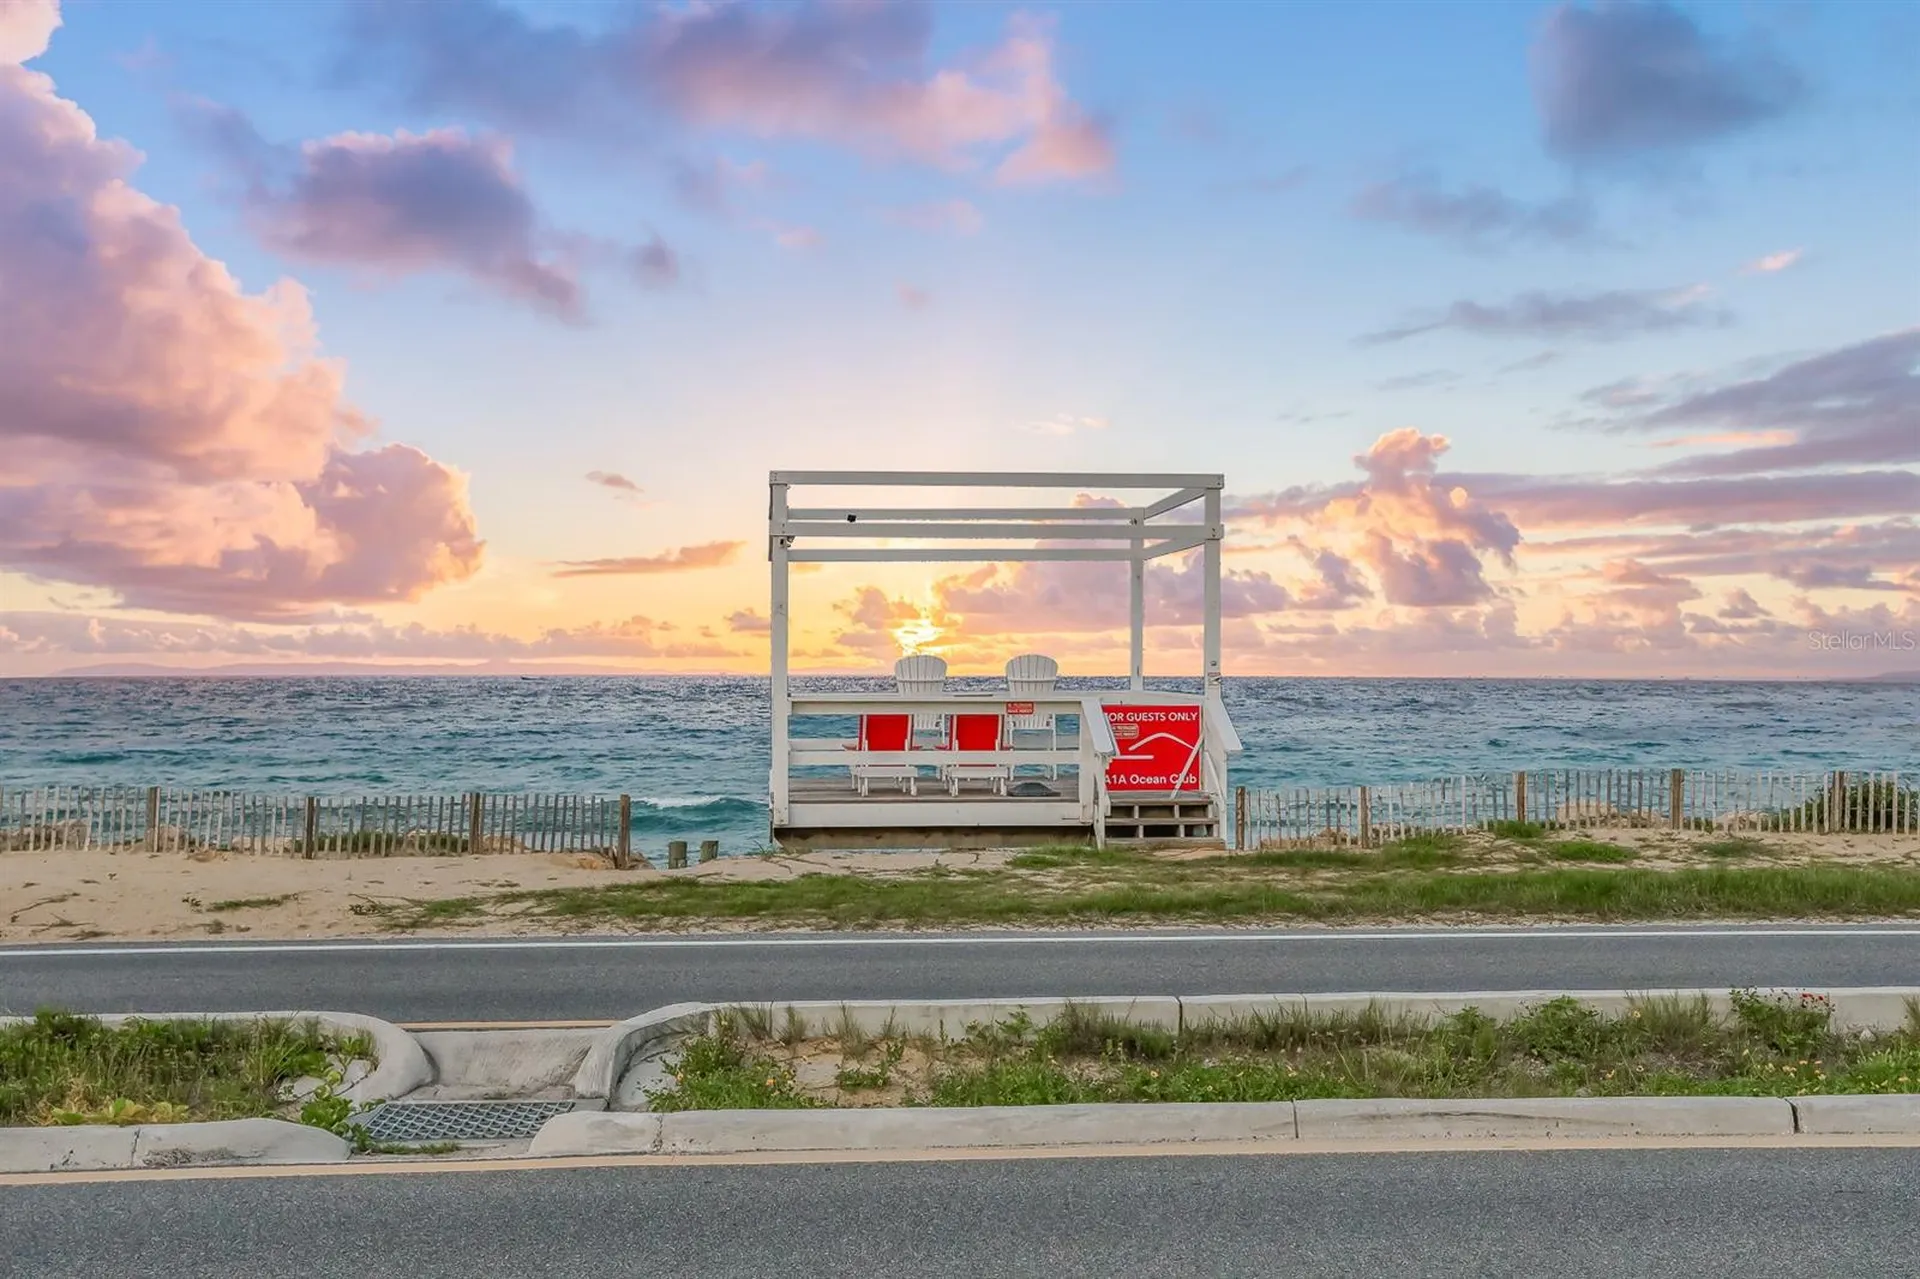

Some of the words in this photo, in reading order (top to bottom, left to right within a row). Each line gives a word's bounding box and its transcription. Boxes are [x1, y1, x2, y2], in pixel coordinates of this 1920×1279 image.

[1104, 712, 1124, 722] OR
[1126, 712, 1166, 722] GUESTS
[1168, 712, 1198, 722] ONLY
[1129, 774, 1166, 784] Ocean
